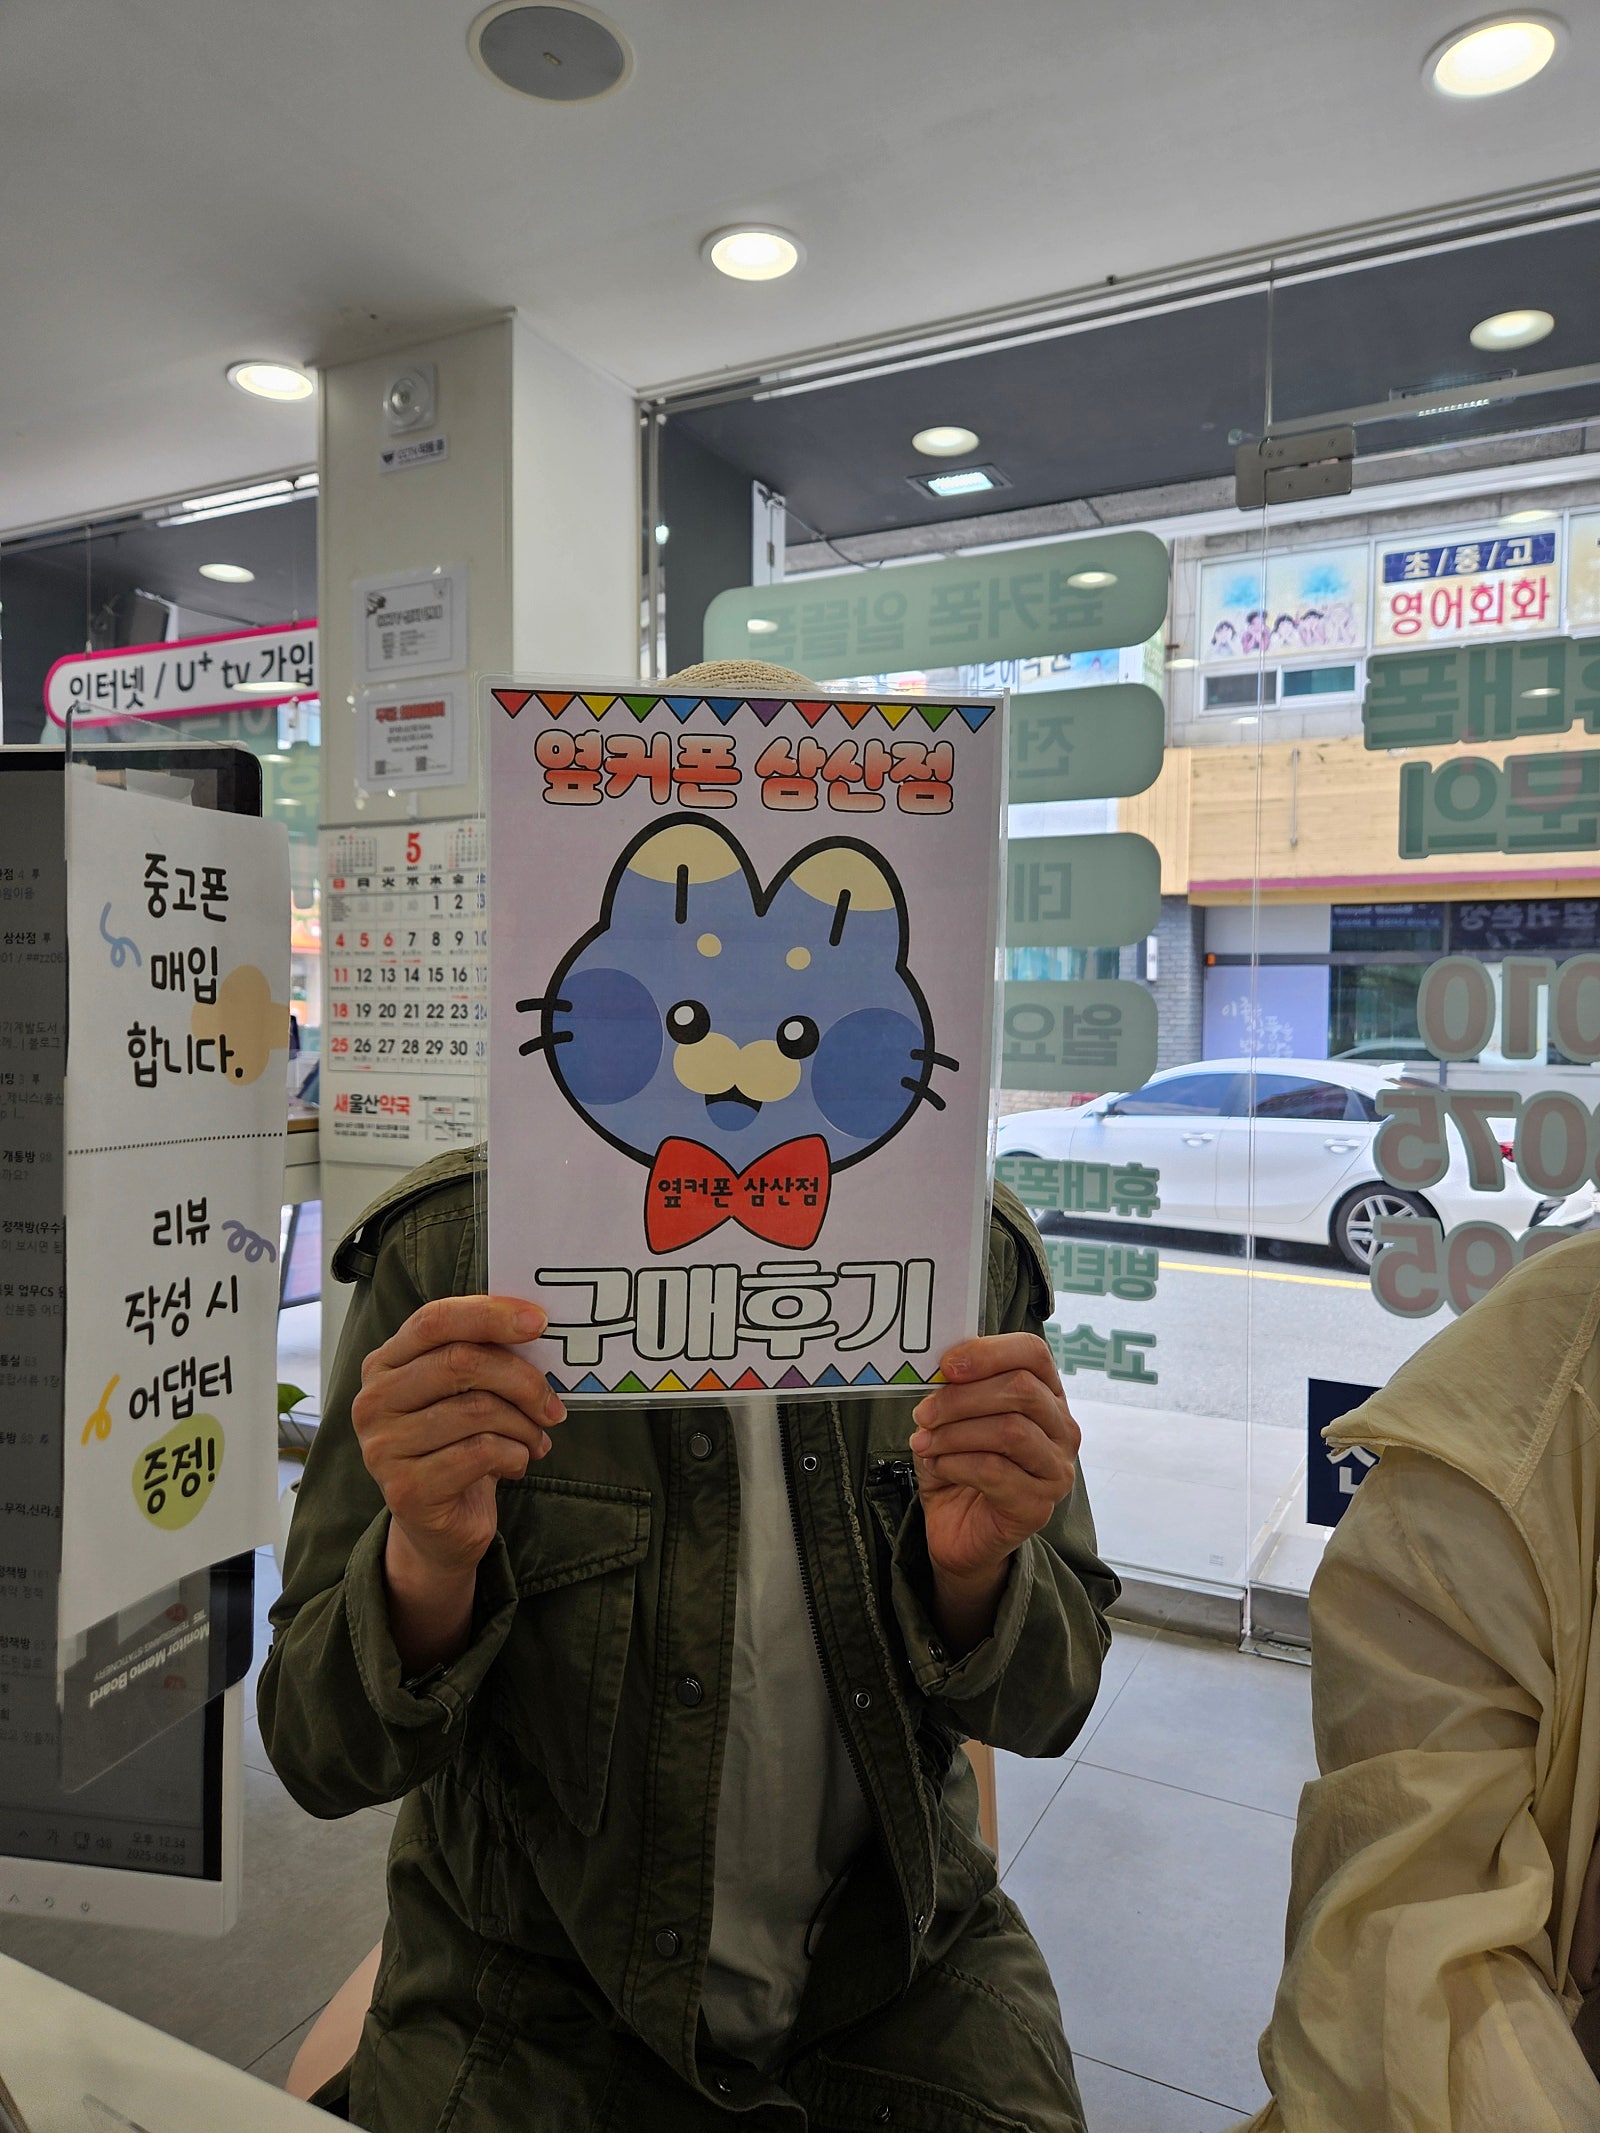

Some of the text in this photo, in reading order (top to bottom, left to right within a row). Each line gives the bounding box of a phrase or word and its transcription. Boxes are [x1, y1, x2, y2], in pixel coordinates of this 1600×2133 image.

[1403, 537, 1533, 580] 초/중/고
[1391, 575, 1551, 635] 영어회화
[69, 665, 145, 713] 인터넷
[154, 662, 166, 699] /
[221, 660, 251, 689] tv
[260, 641, 315, 687] 가입
[534, 729, 955, 815] 옆커폰 삼산점
[406, 832, 422, 864] 5
[143, 853, 229, 922] 중고폰
[434, 895, 440, 910] 1
[455, 894, 463, 910] 2
[336, 933, 345, 947] 4
[360, 932, 369, 948] 5
[384, 931, 393, 947] 6
[408, 931, 416, 947] 7
[432, 931, 441, 947] 8
[455, 930, 464, 946] 9
[151, 946, 219, 1005] 매입
[334, 968, 348, 983] 11
[356, 968, 372, 983] 12
[380, 968, 396, 983] 13
[404, 968, 420, 983] 14
[428, 967, 444, 982] 15
[452, 967, 468, 982] 16
[332, 1003, 349, 1018] 18
[356, 1003, 372, 1018] 19
[378, 1003, 396, 1018] 20
[403, 1003, 419, 1019] 21
[426, 1003, 445, 1019] 22
[450, 1003, 468, 1019] 23
[127, 1021, 244, 1088] 합니다.
[331, 1038, 349, 1053] 25
[354, 1038, 372, 1053] 26
[378, 1038, 396, 1054] 27
[402, 1039, 420, 1054] 28
[425, 1040, 444, 1055] 29
[450, 1040, 468, 1055] 30
[334, 1093, 412, 1116] 새울산약국
[657, 1176, 820, 1209] 옆커폰 삼산점
[2, 1220, 65, 1235] 정책방(우수
[153, 1197, 211, 1246] 리뷰
[126, 1275, 239, 1345] 작성 시
[535, 1258, 935, 1366] 구매후기
[129, 1355, 234, 1420] 어댑터
[143, 1437, 216, 1515] 증정!
[89, 1621, 210, 1709] Monitor Memo Board
